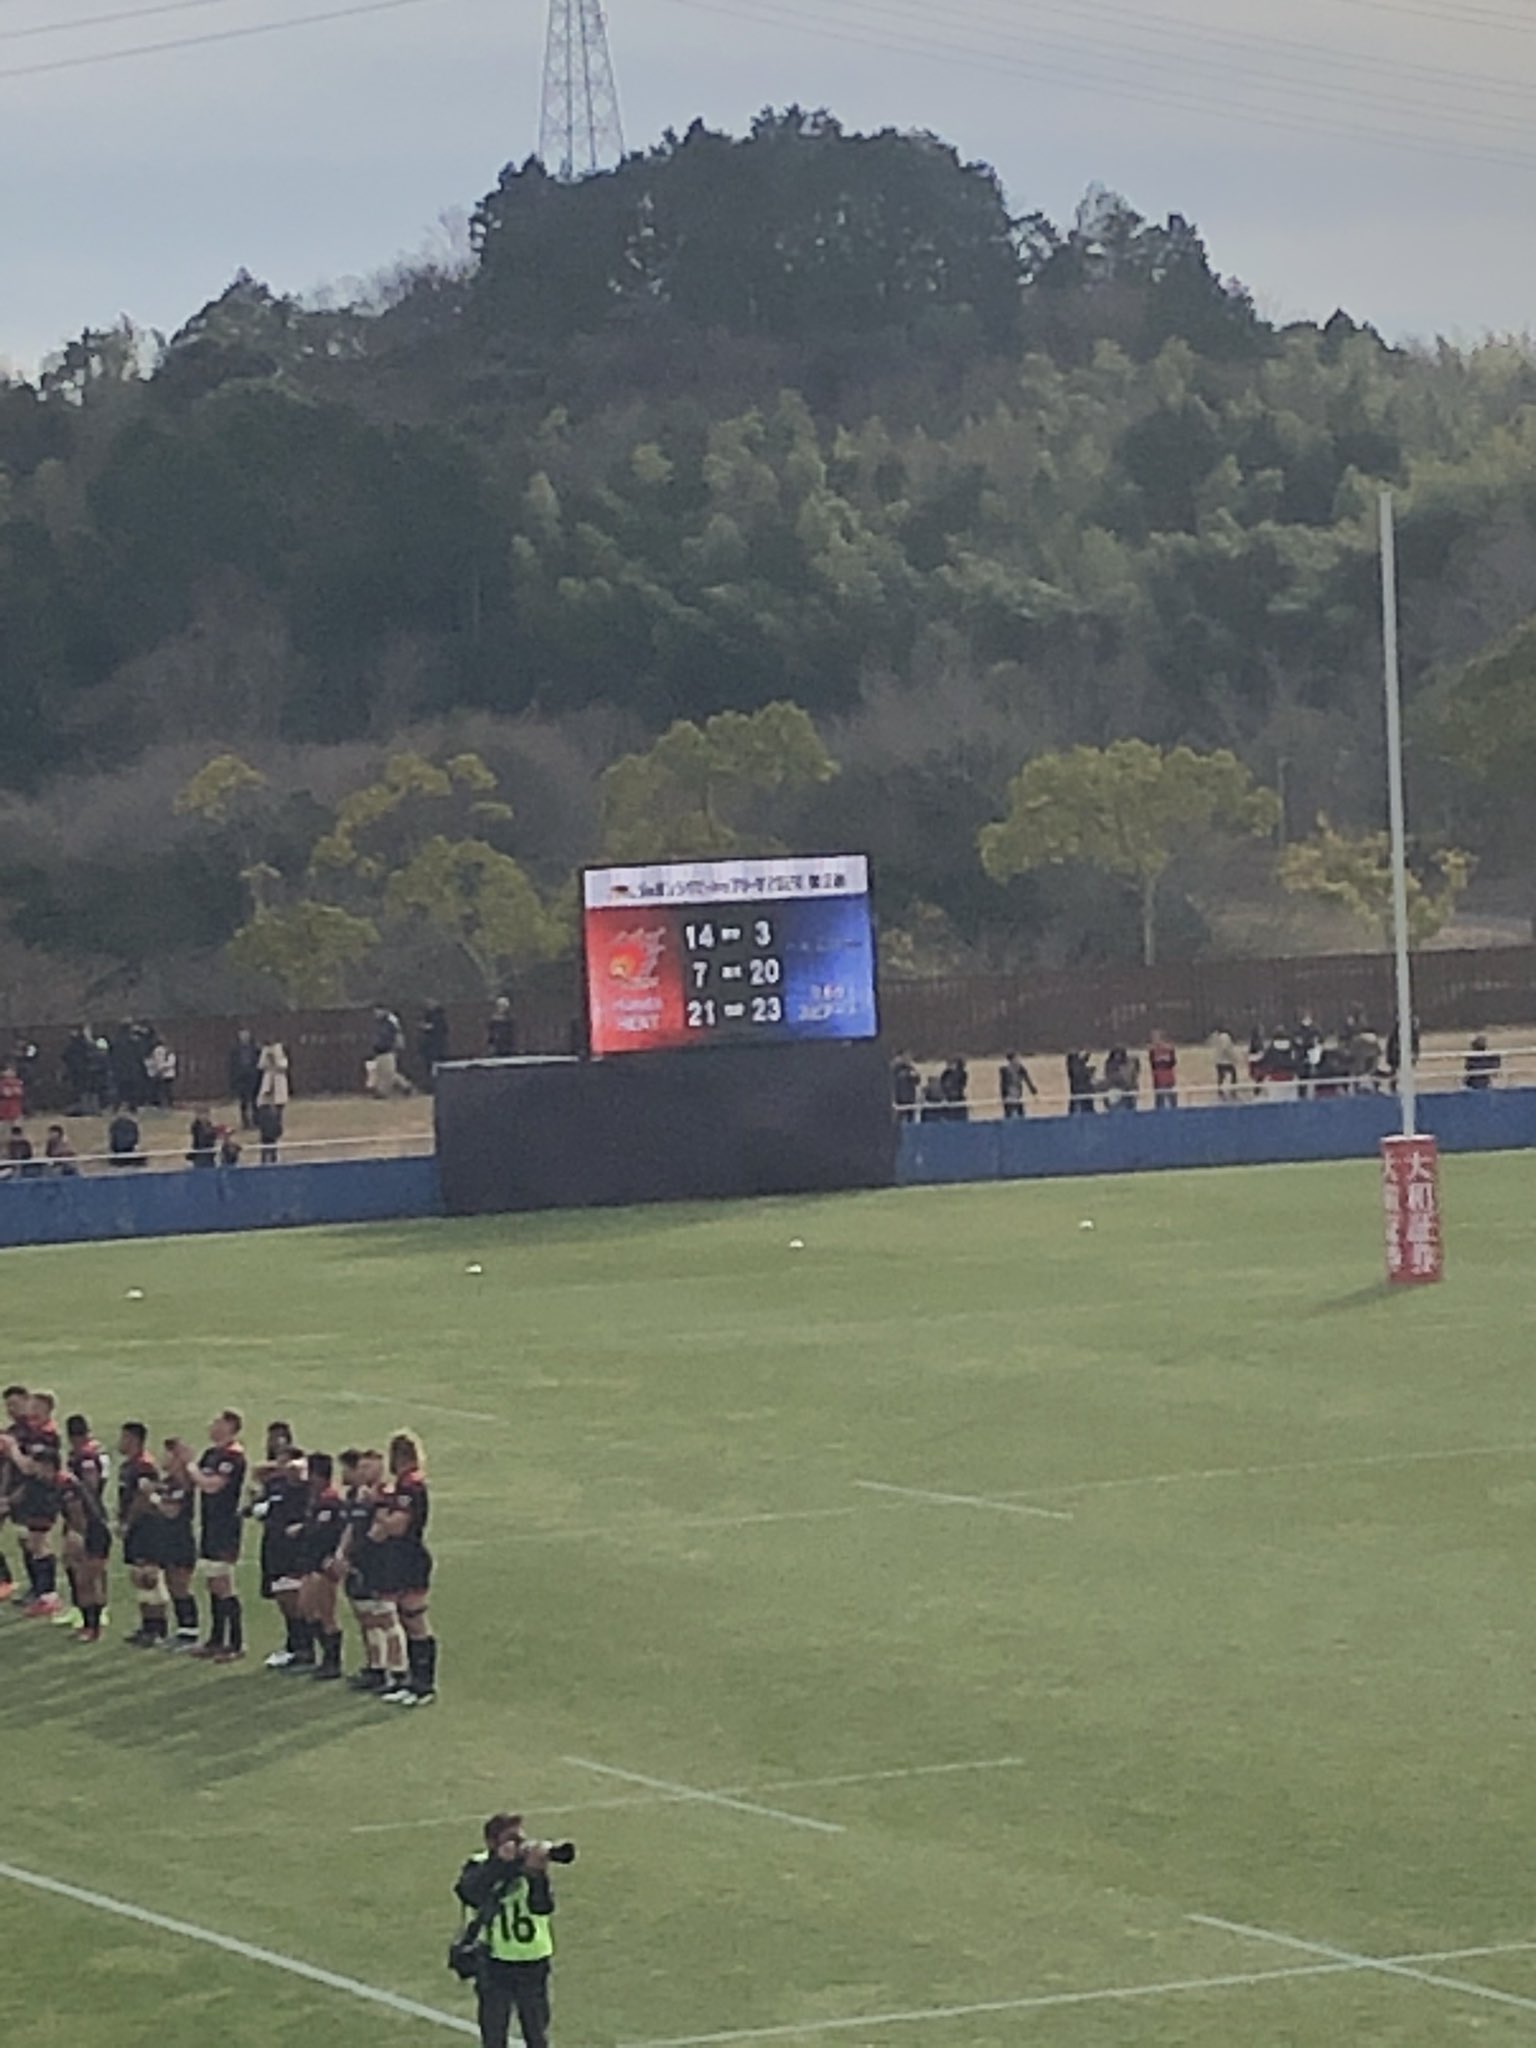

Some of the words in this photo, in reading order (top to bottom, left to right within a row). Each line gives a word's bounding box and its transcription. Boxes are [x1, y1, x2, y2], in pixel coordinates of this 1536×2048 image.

[686, 923, 715, 949] 14
[754, 920, 771, 945] 3
[693, 961, 708, 988] 7
[750, 959, 780, 985] 20
[688, 999, 716, 1026] 21
[752, 997, 782, 1021] 23
[500, 1899, 536, 1943] 16
